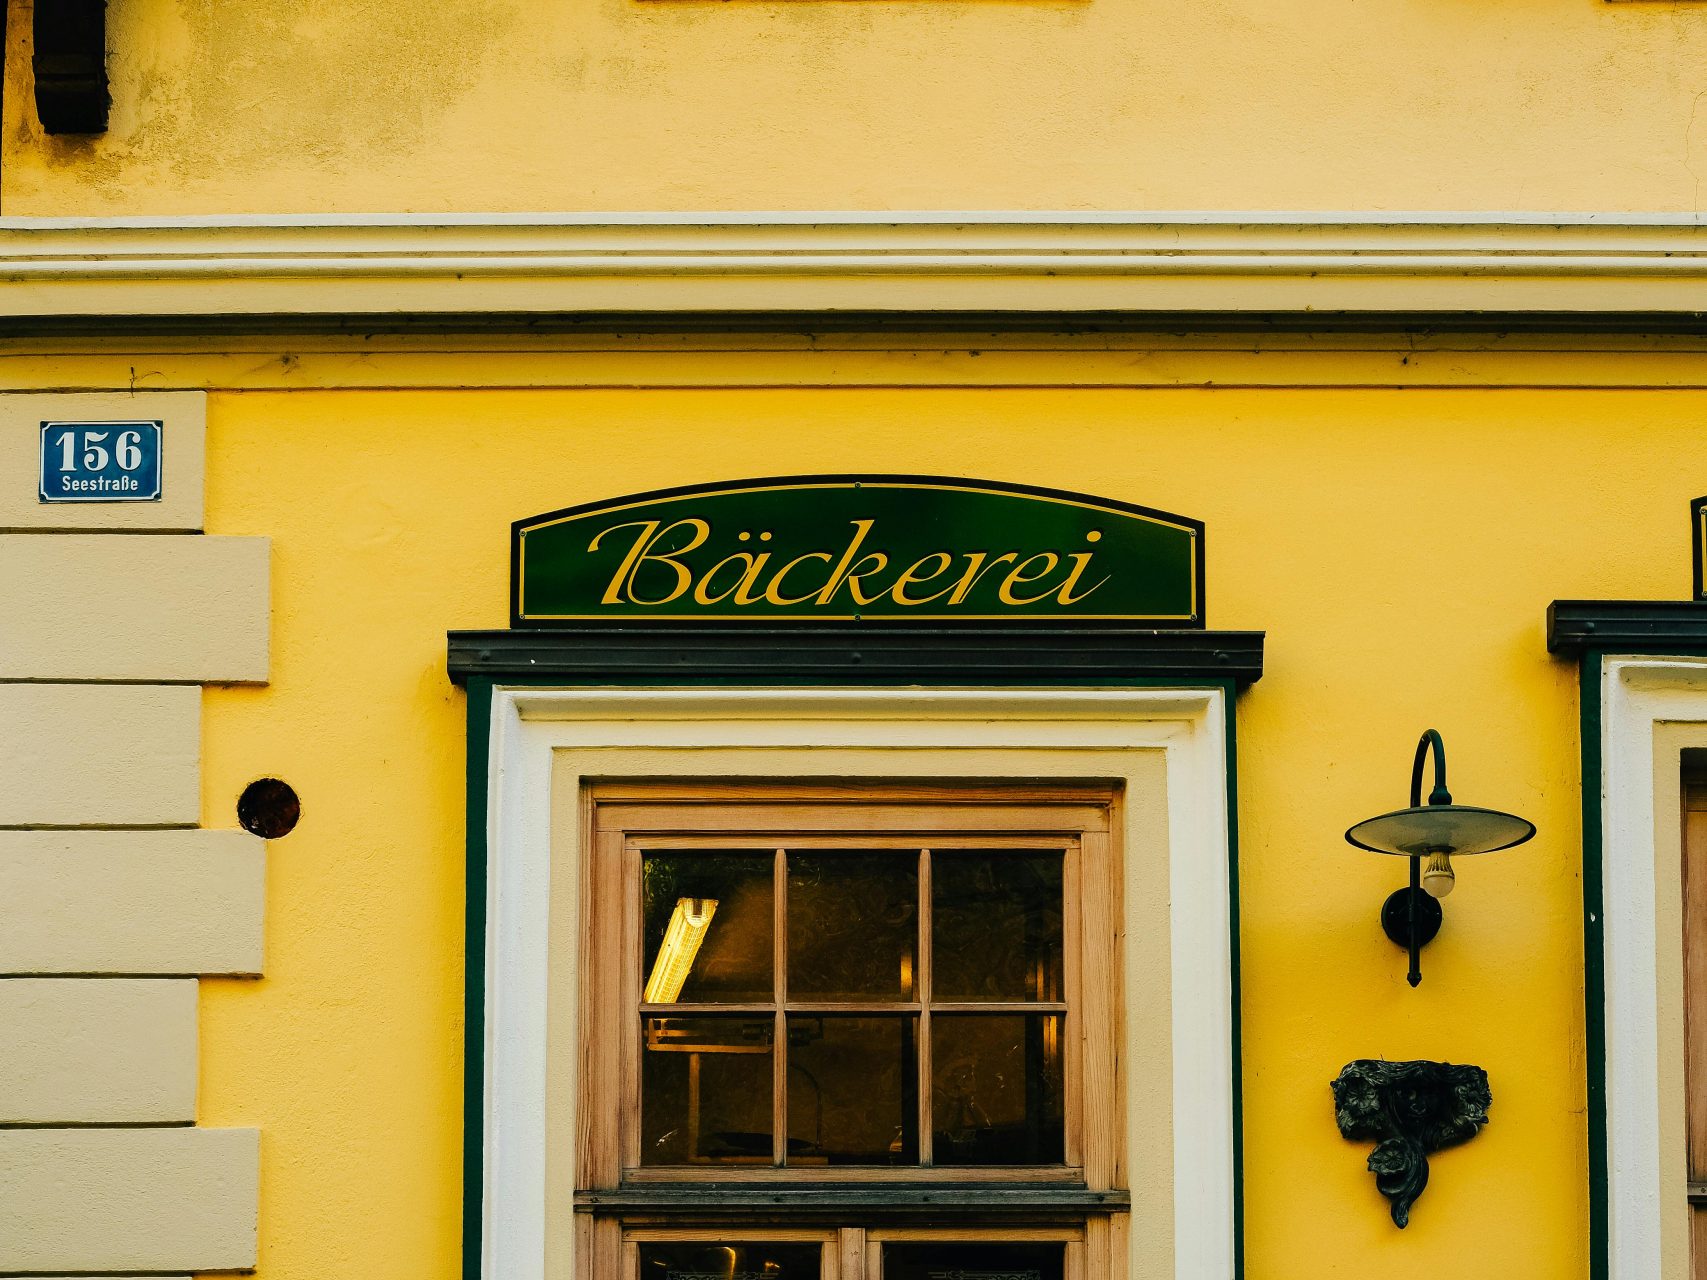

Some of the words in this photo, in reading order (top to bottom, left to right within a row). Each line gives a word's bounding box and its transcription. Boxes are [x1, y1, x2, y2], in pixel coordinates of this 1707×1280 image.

[56, 431, 142, 472] 156
[62, 475, 138, 491] Seestraße
[587, 517, 1112, 606] Bäckerei
